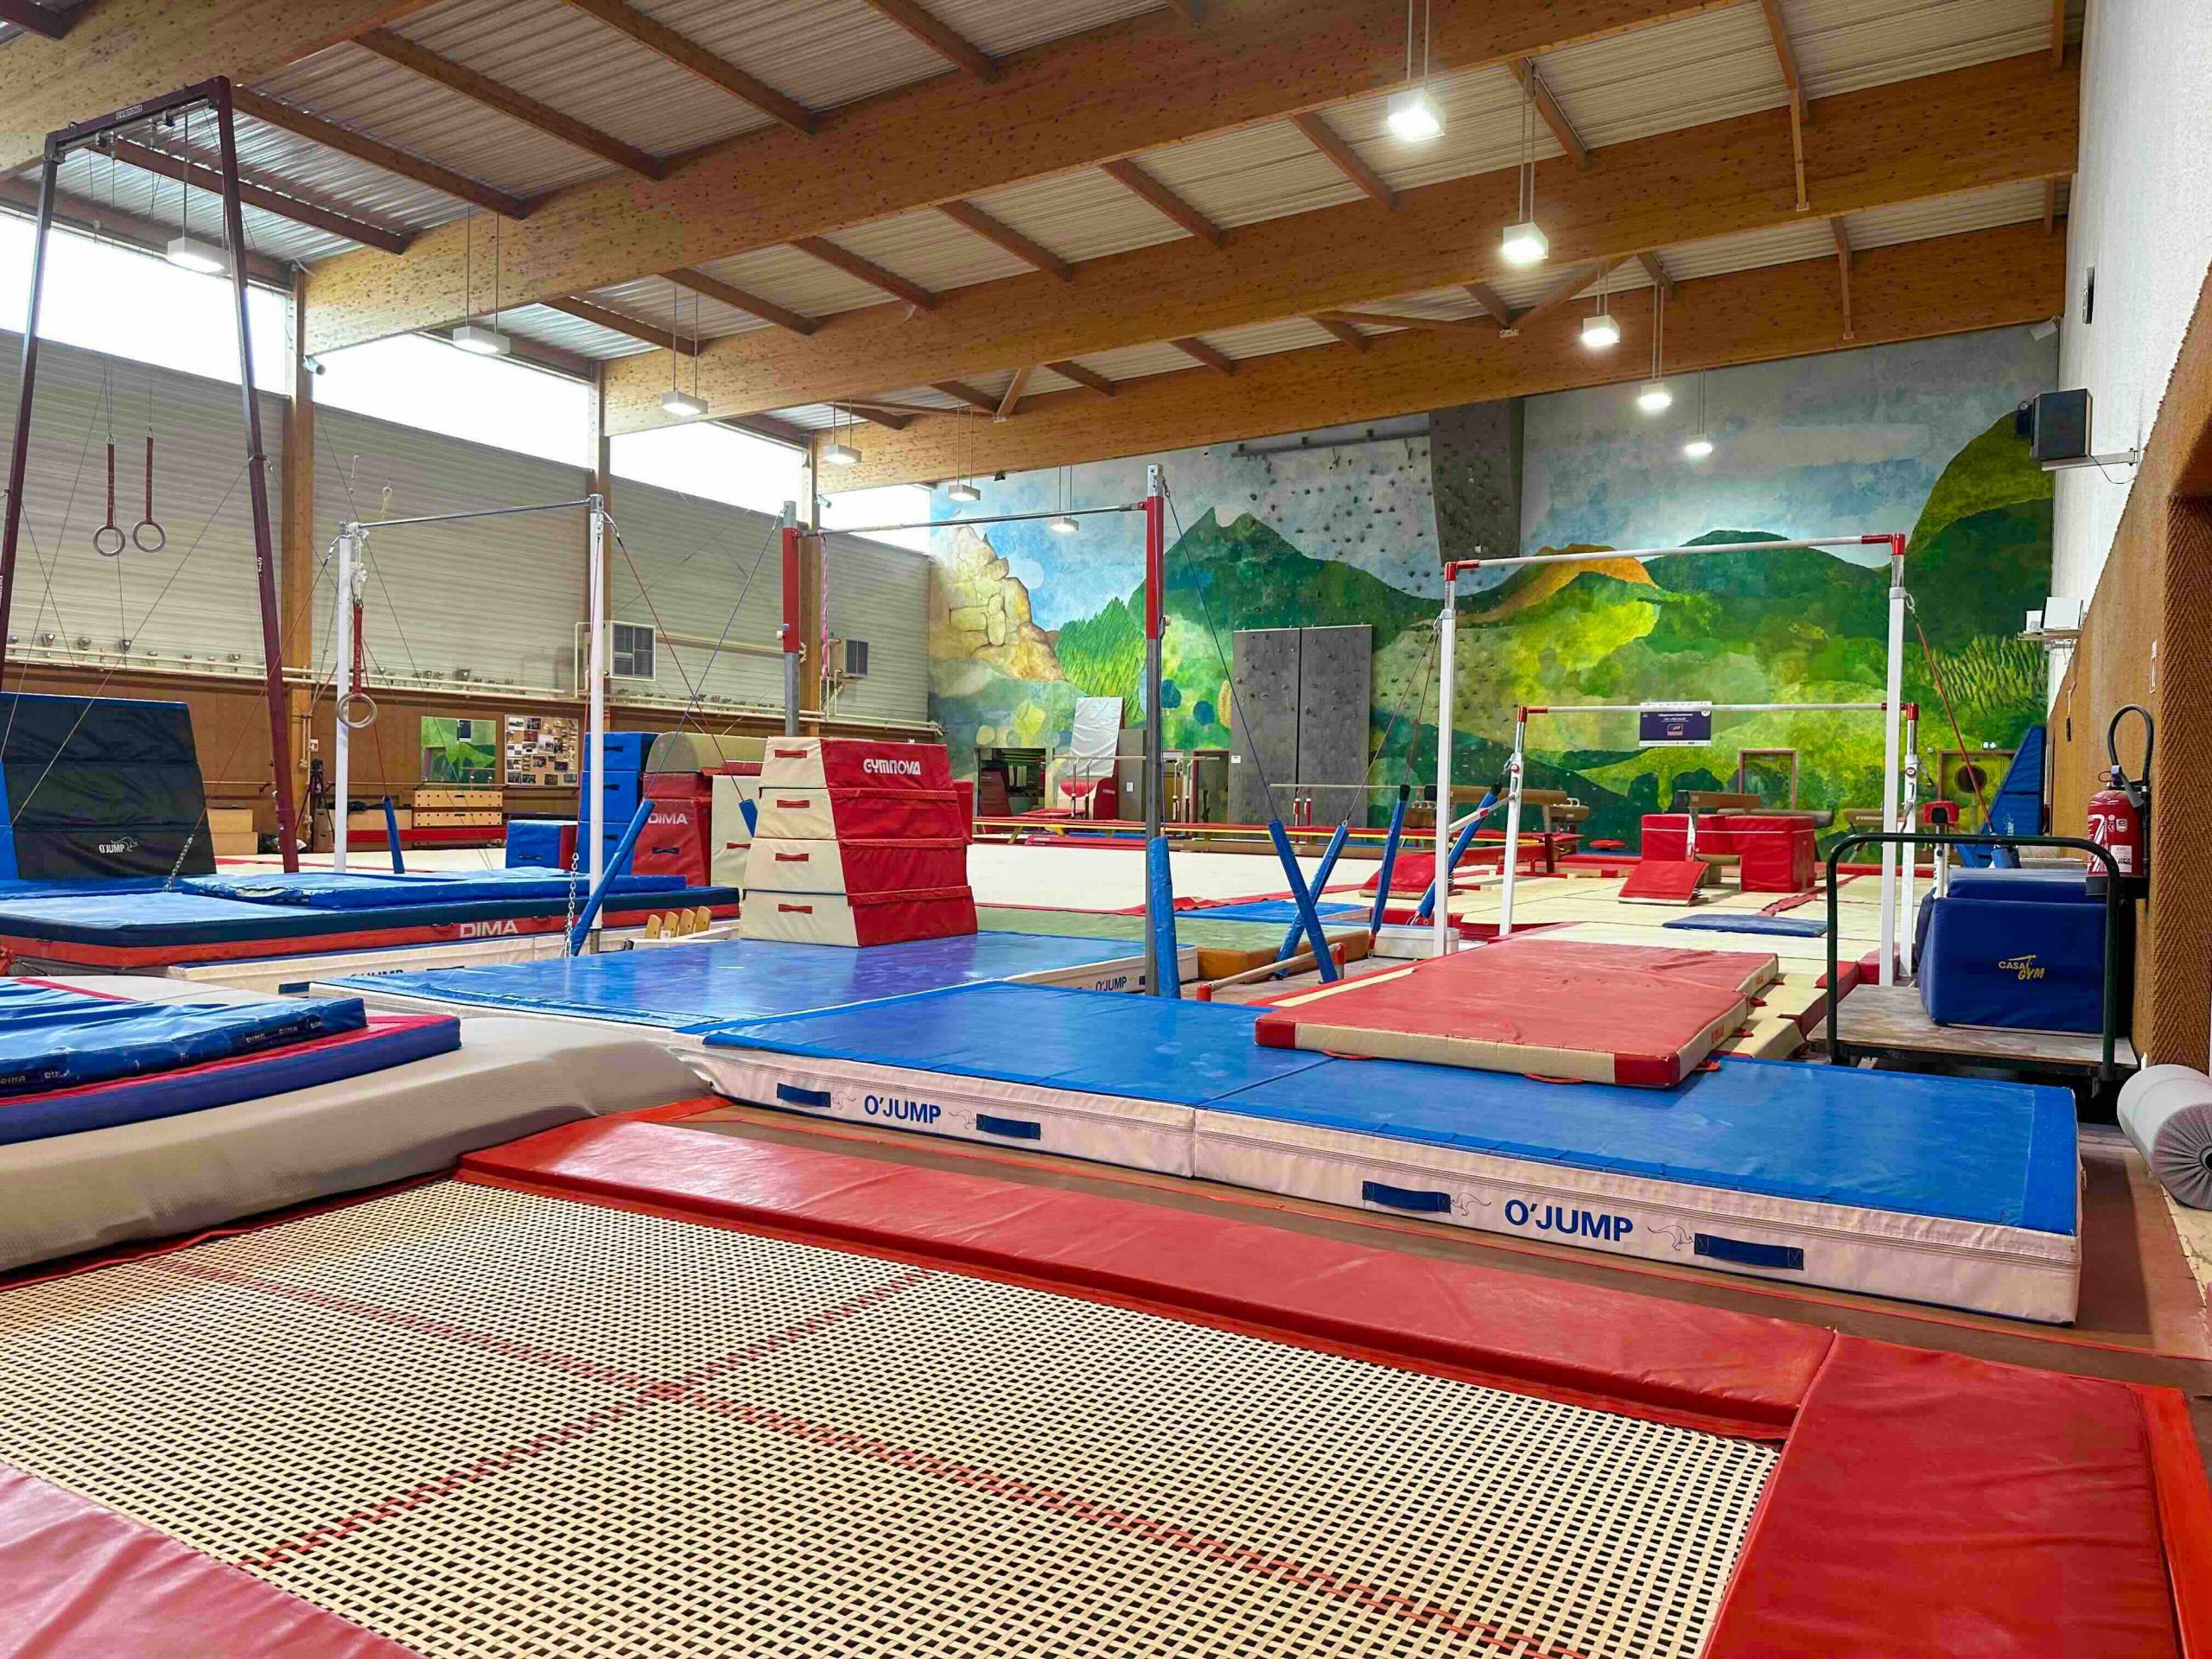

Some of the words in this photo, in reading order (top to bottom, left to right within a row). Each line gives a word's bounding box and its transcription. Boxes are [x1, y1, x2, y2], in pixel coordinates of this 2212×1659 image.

[863, 759, 921, 775] GYMNOVA
[99, 843, 125, 854] O'JUMP
[1998, 961, 2025, 969] CASA
[2018, 967, 2045, 980] GYM
[1096, 976, 1127, 991] O'JUMP
[864, 1095, 941, 1124] O'JUMP
[1504, 1198, 1633, 1242] O'JUMP
